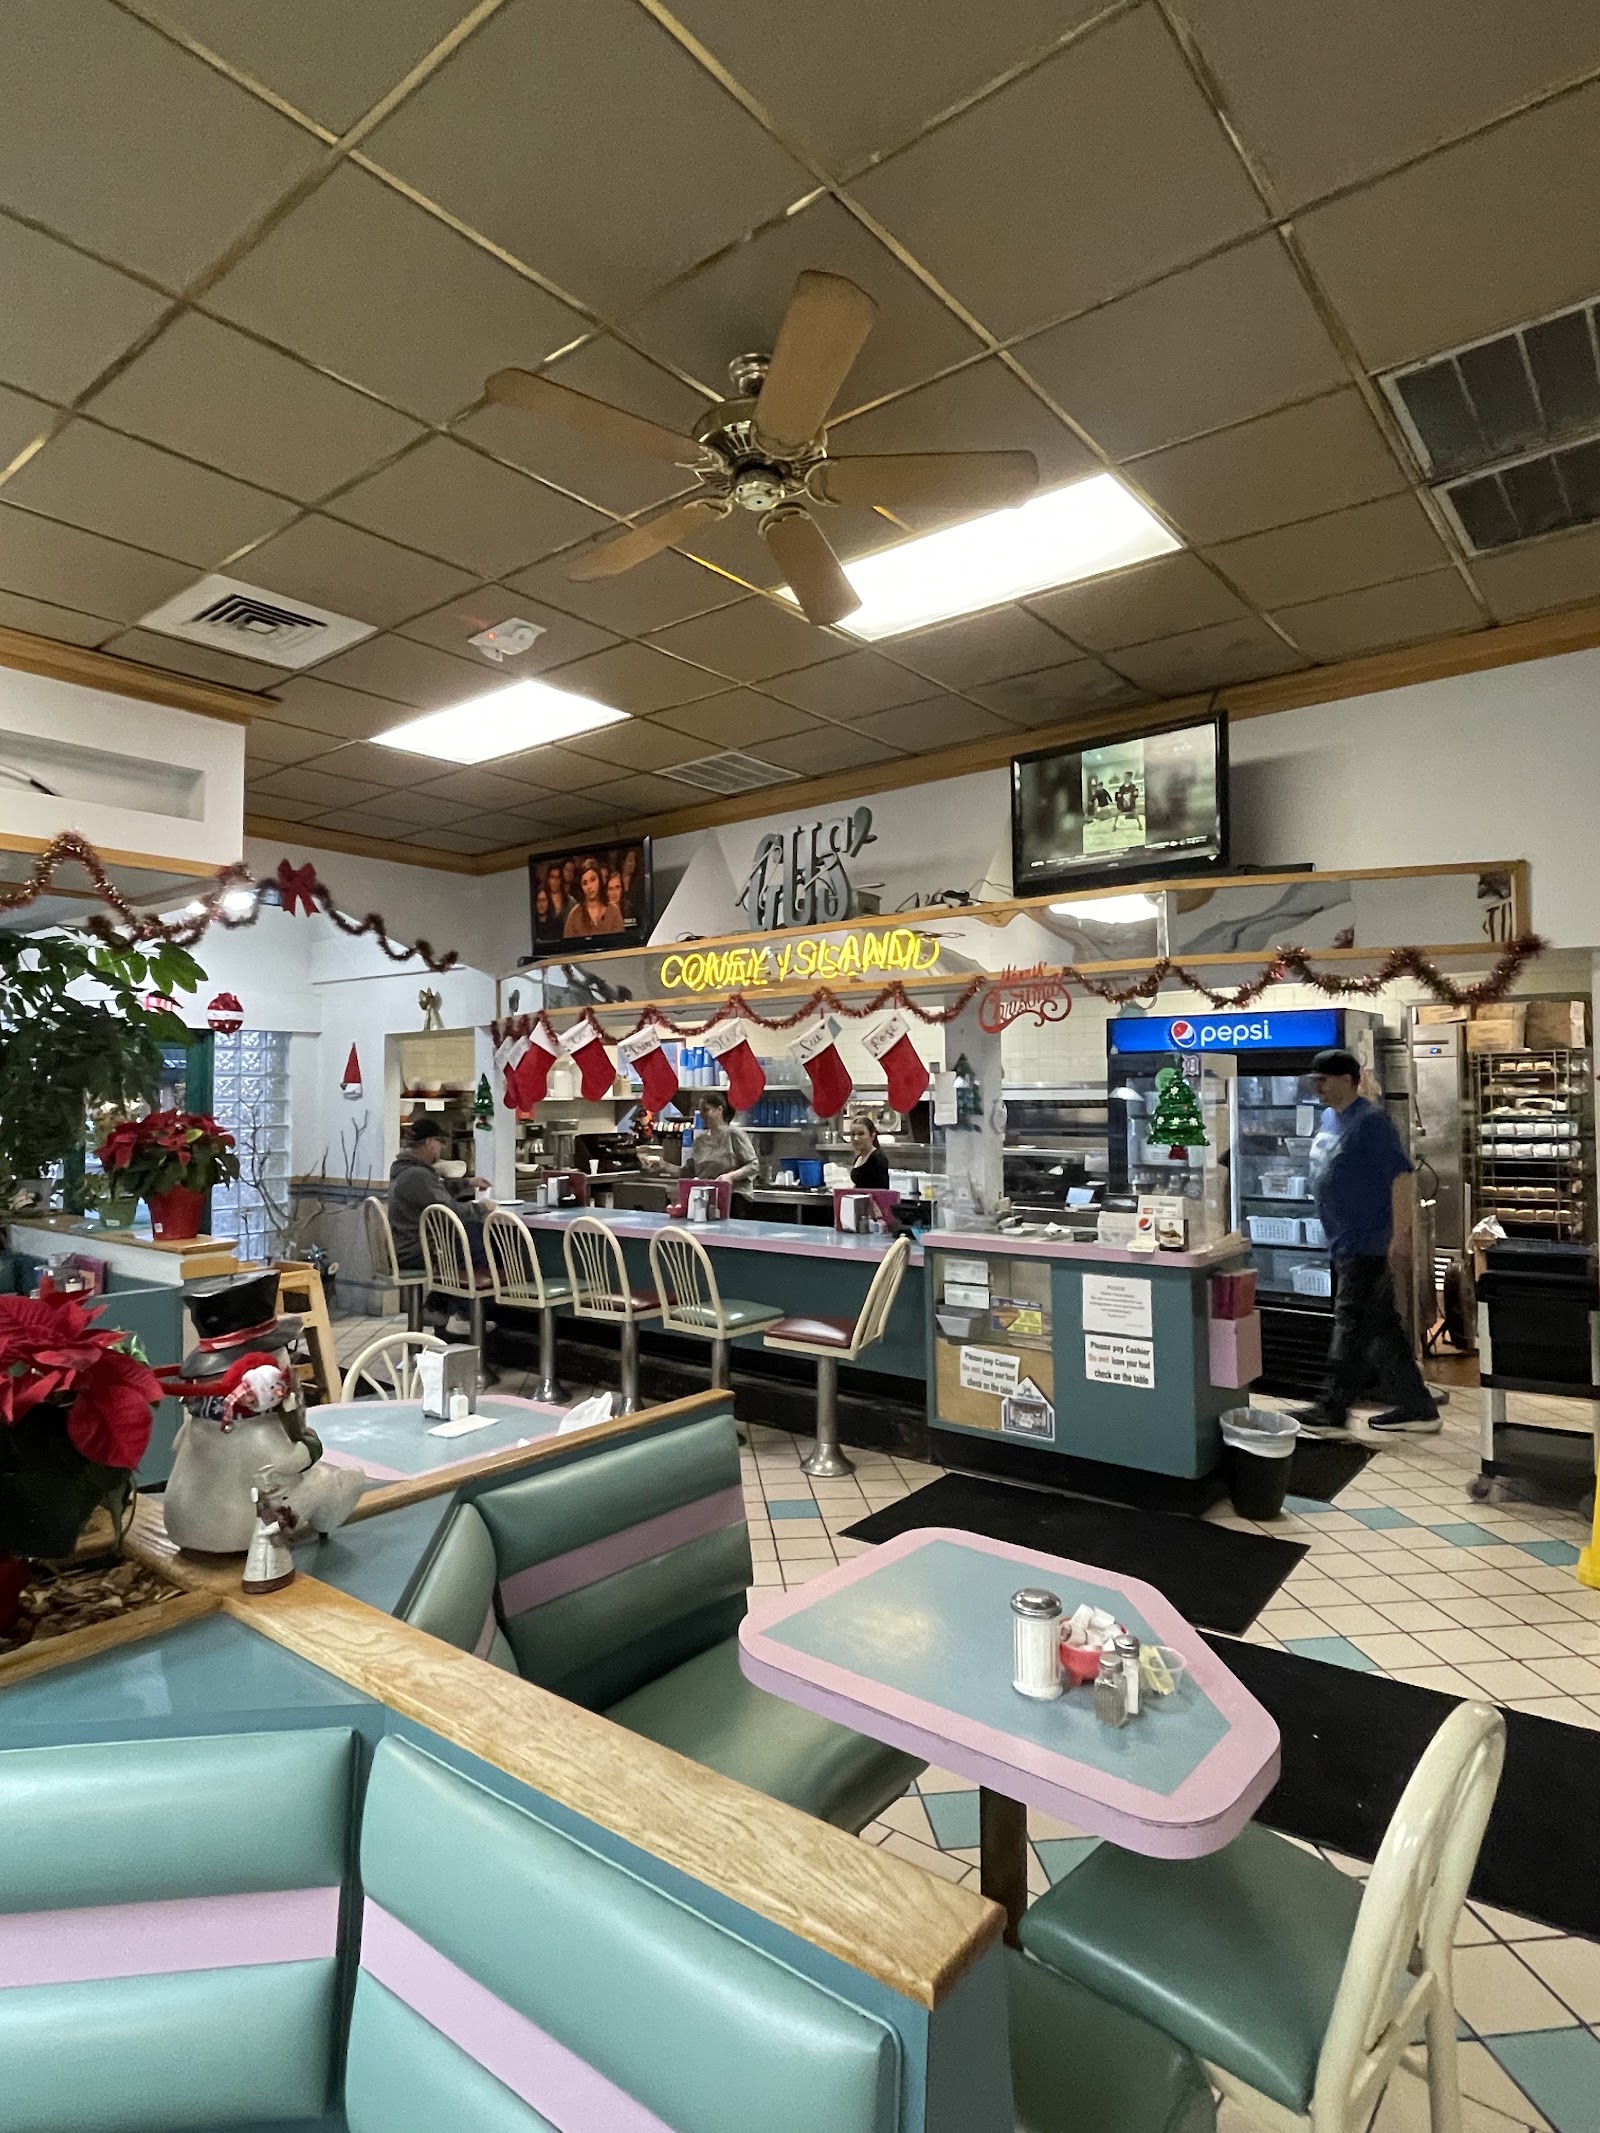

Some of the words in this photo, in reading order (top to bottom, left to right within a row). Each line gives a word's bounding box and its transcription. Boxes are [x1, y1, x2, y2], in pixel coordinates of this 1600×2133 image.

[660, 946, 769, 992] CONEY
[778, 929, 918, 981] ISLAND
[1201, 1019, 1269, 1047] pepsi
[1113, 1345, 1124, 1354] pay
[1125, 1345, 1151, 1356] Cashier
[984, 1357, 993, 1366] pay
[1122, 1372, 1132, 1382] the
